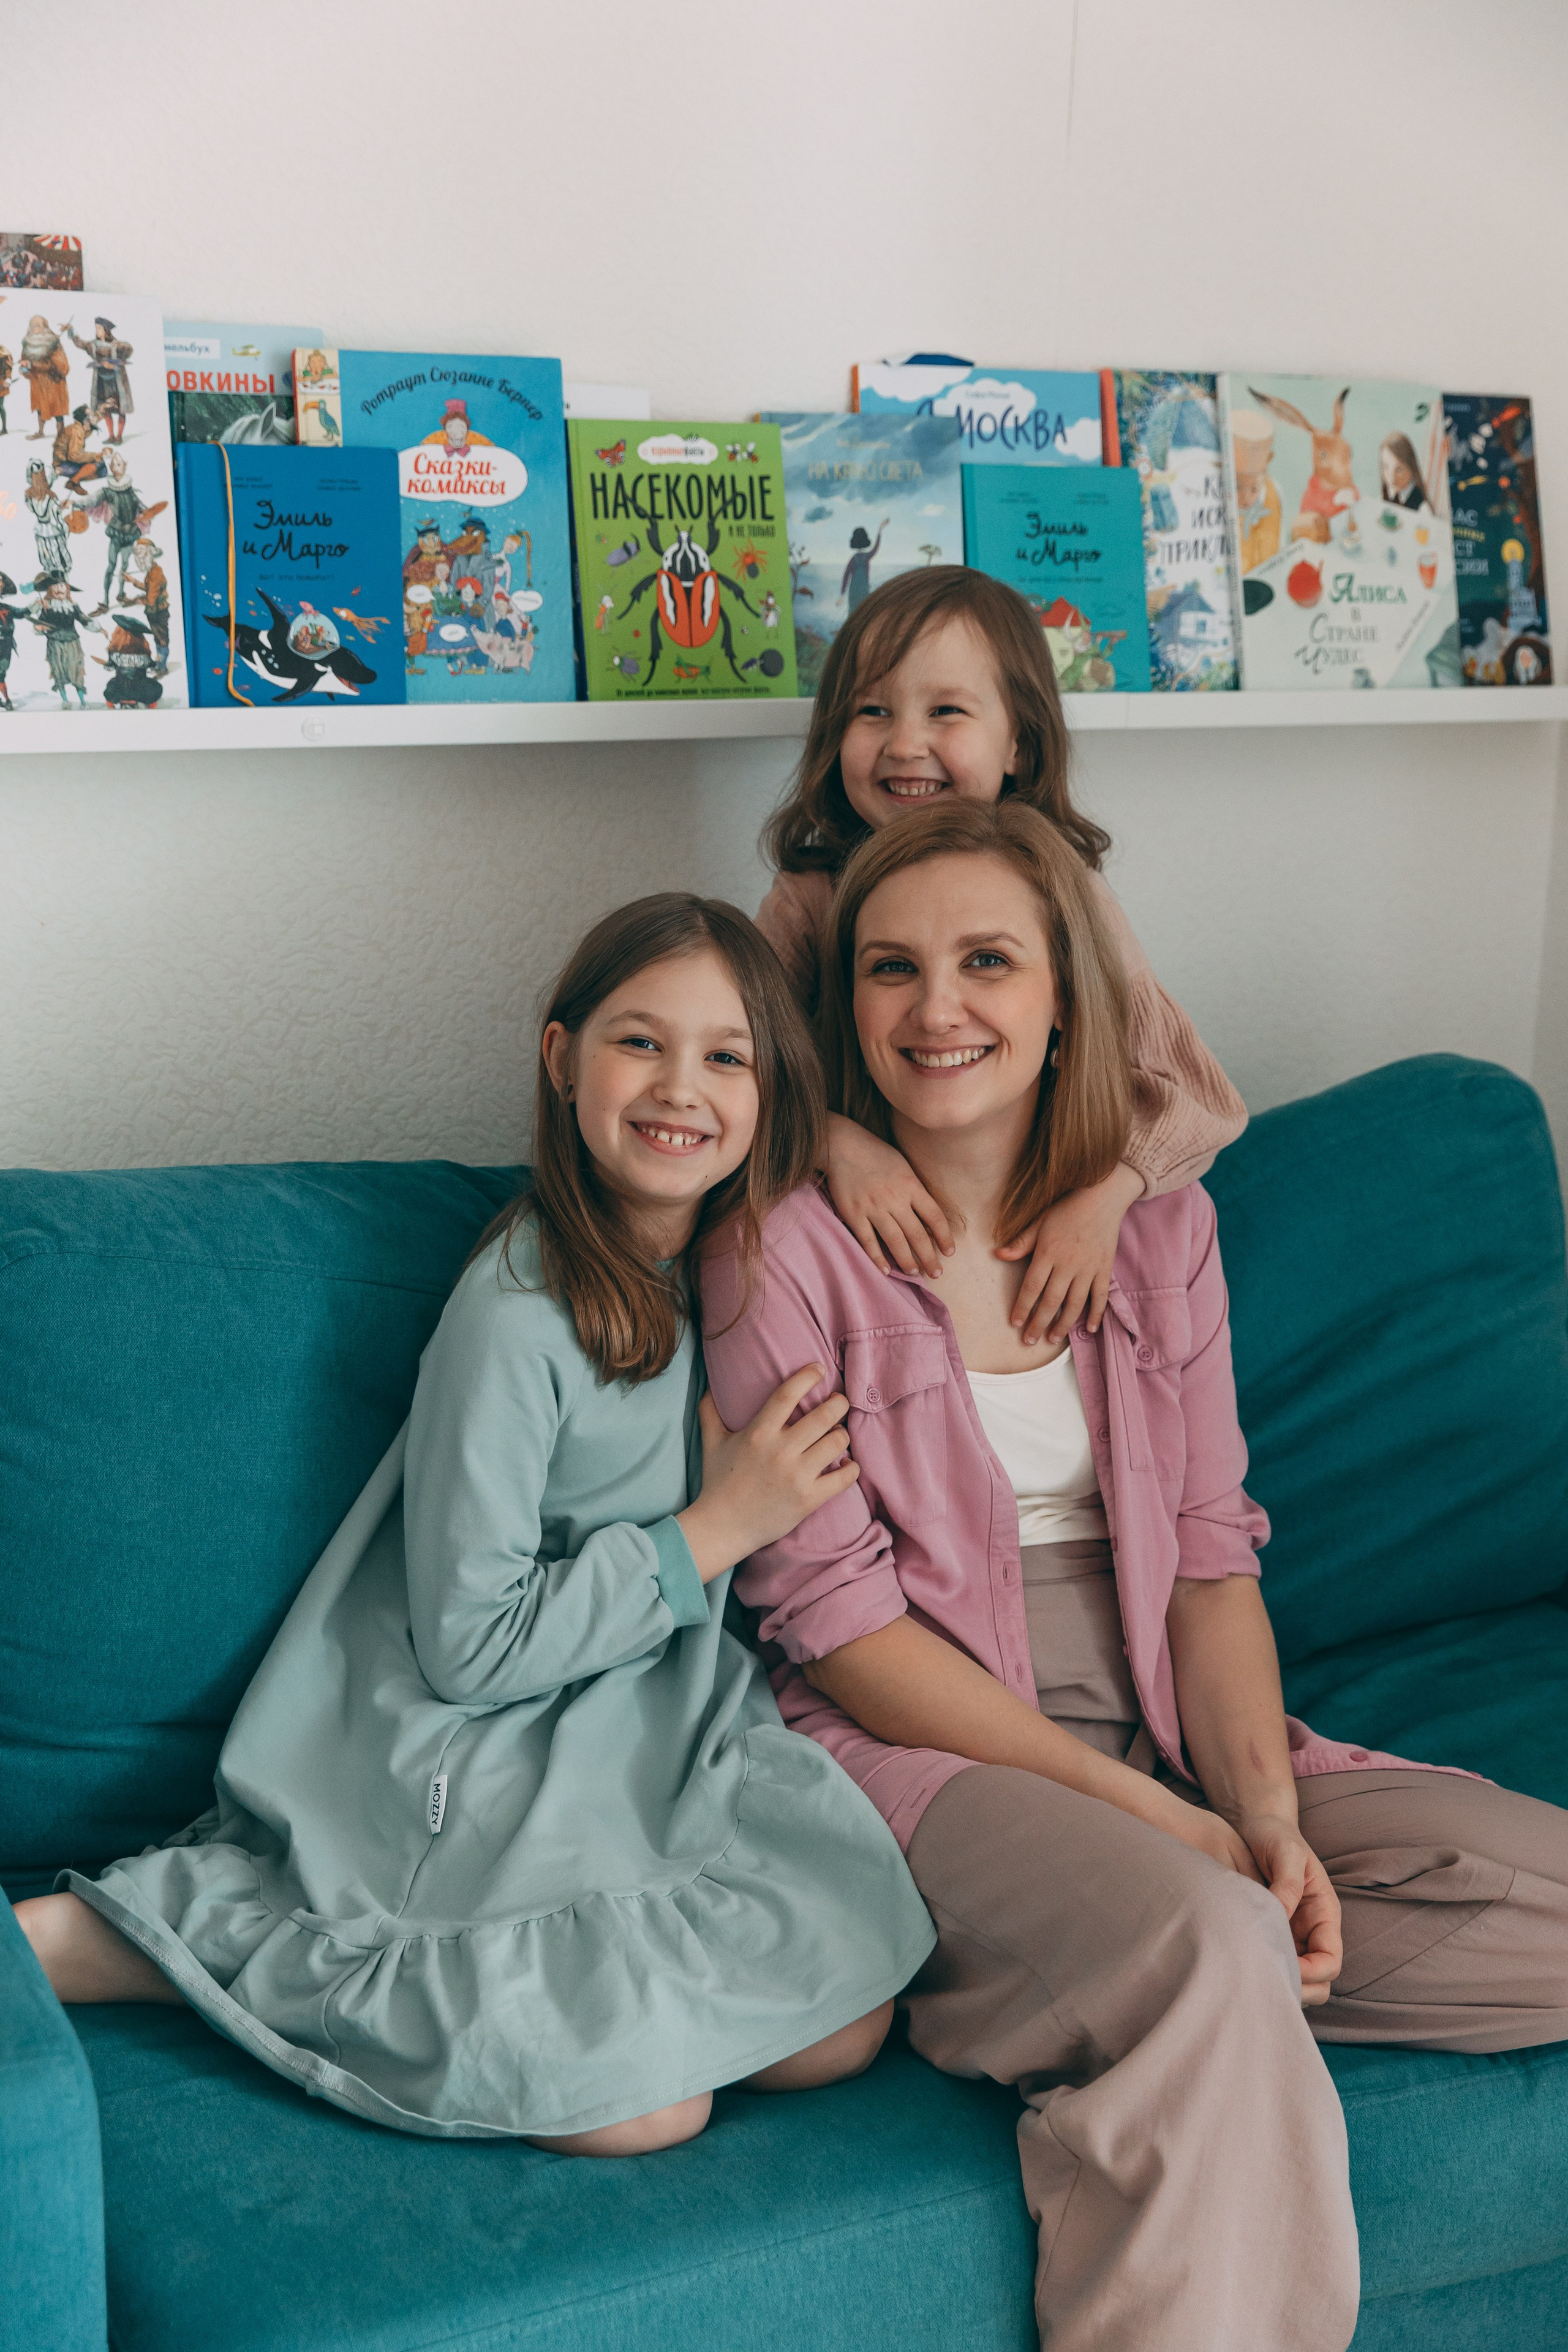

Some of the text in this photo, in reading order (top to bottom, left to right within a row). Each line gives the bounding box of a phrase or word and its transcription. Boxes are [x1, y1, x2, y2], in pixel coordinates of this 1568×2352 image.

[166, 369, 275, 394] ОВКИНЫ
[360, 366, 543, 421] Ротраут Сюзанне Бернер
[413, 452, 498, 481] Сказки-
[407, 477, 506, 496] комиксы
[589, 472, 775, 520] НАСЕКОМЫЕ
[253, 499, 333, 530] Эмиль
[1025, 512, 1089, 540] Эмиль
[242, 529, 350, 570] и Марго
[1016, 538, 1102, 573] и Марго
[431, 1783, 441, 1825] MOZZY
